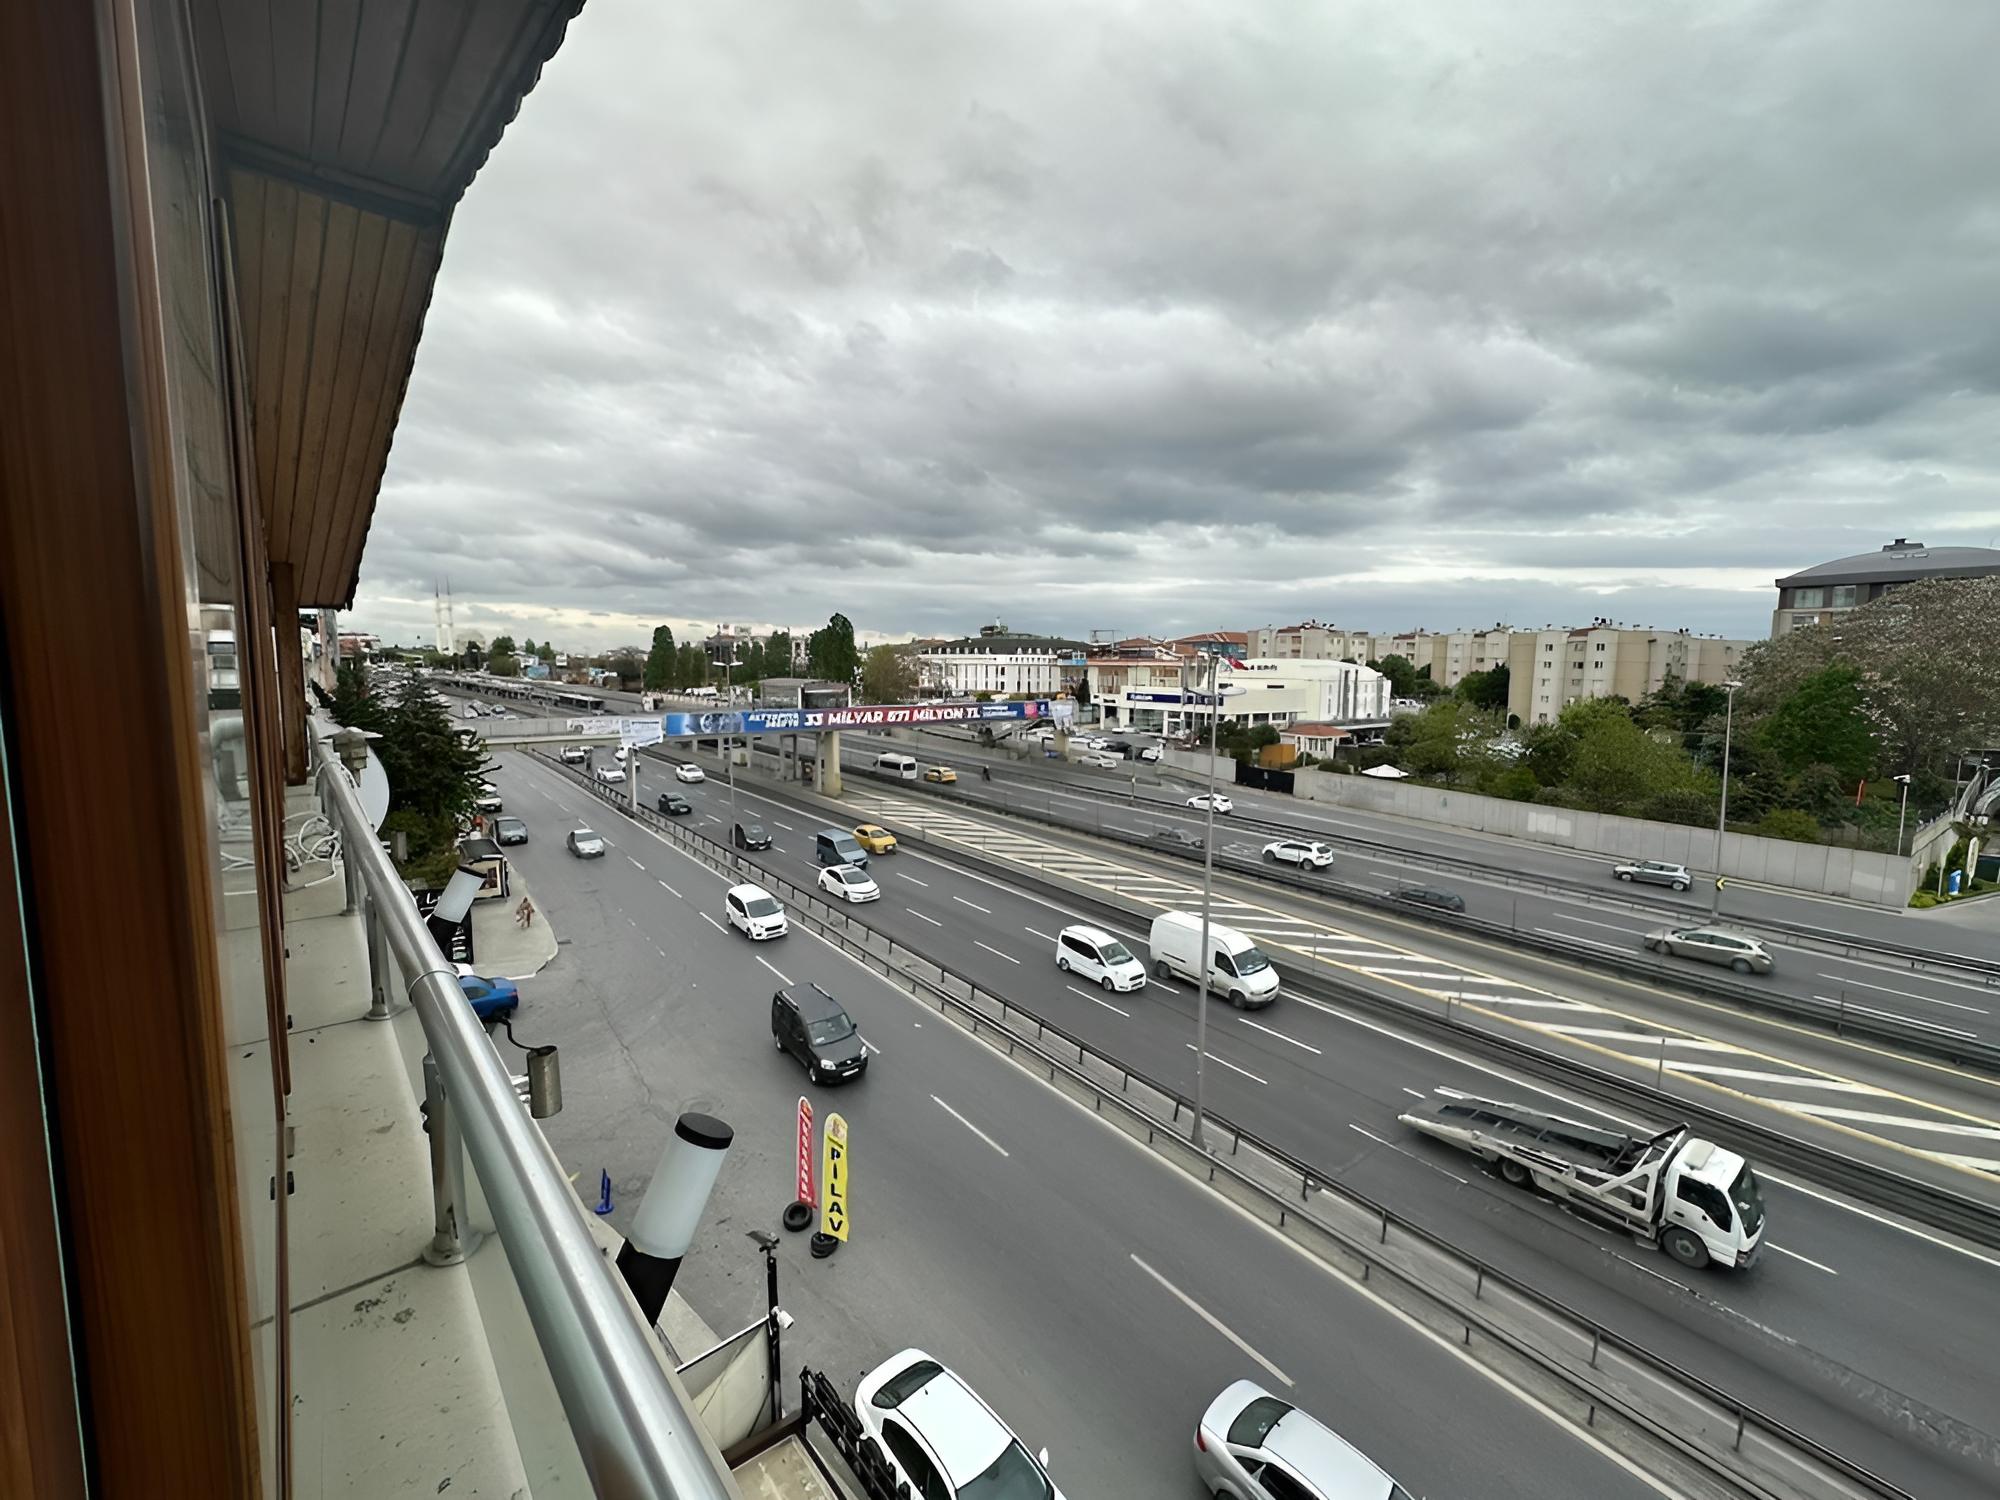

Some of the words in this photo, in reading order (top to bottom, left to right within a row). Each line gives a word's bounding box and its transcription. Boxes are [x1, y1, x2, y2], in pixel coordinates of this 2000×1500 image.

[828, 710, 883, 725] MİLYAR
[912, 707, 964, 721] MİLYON
[966, 707, 981, 719] TL
